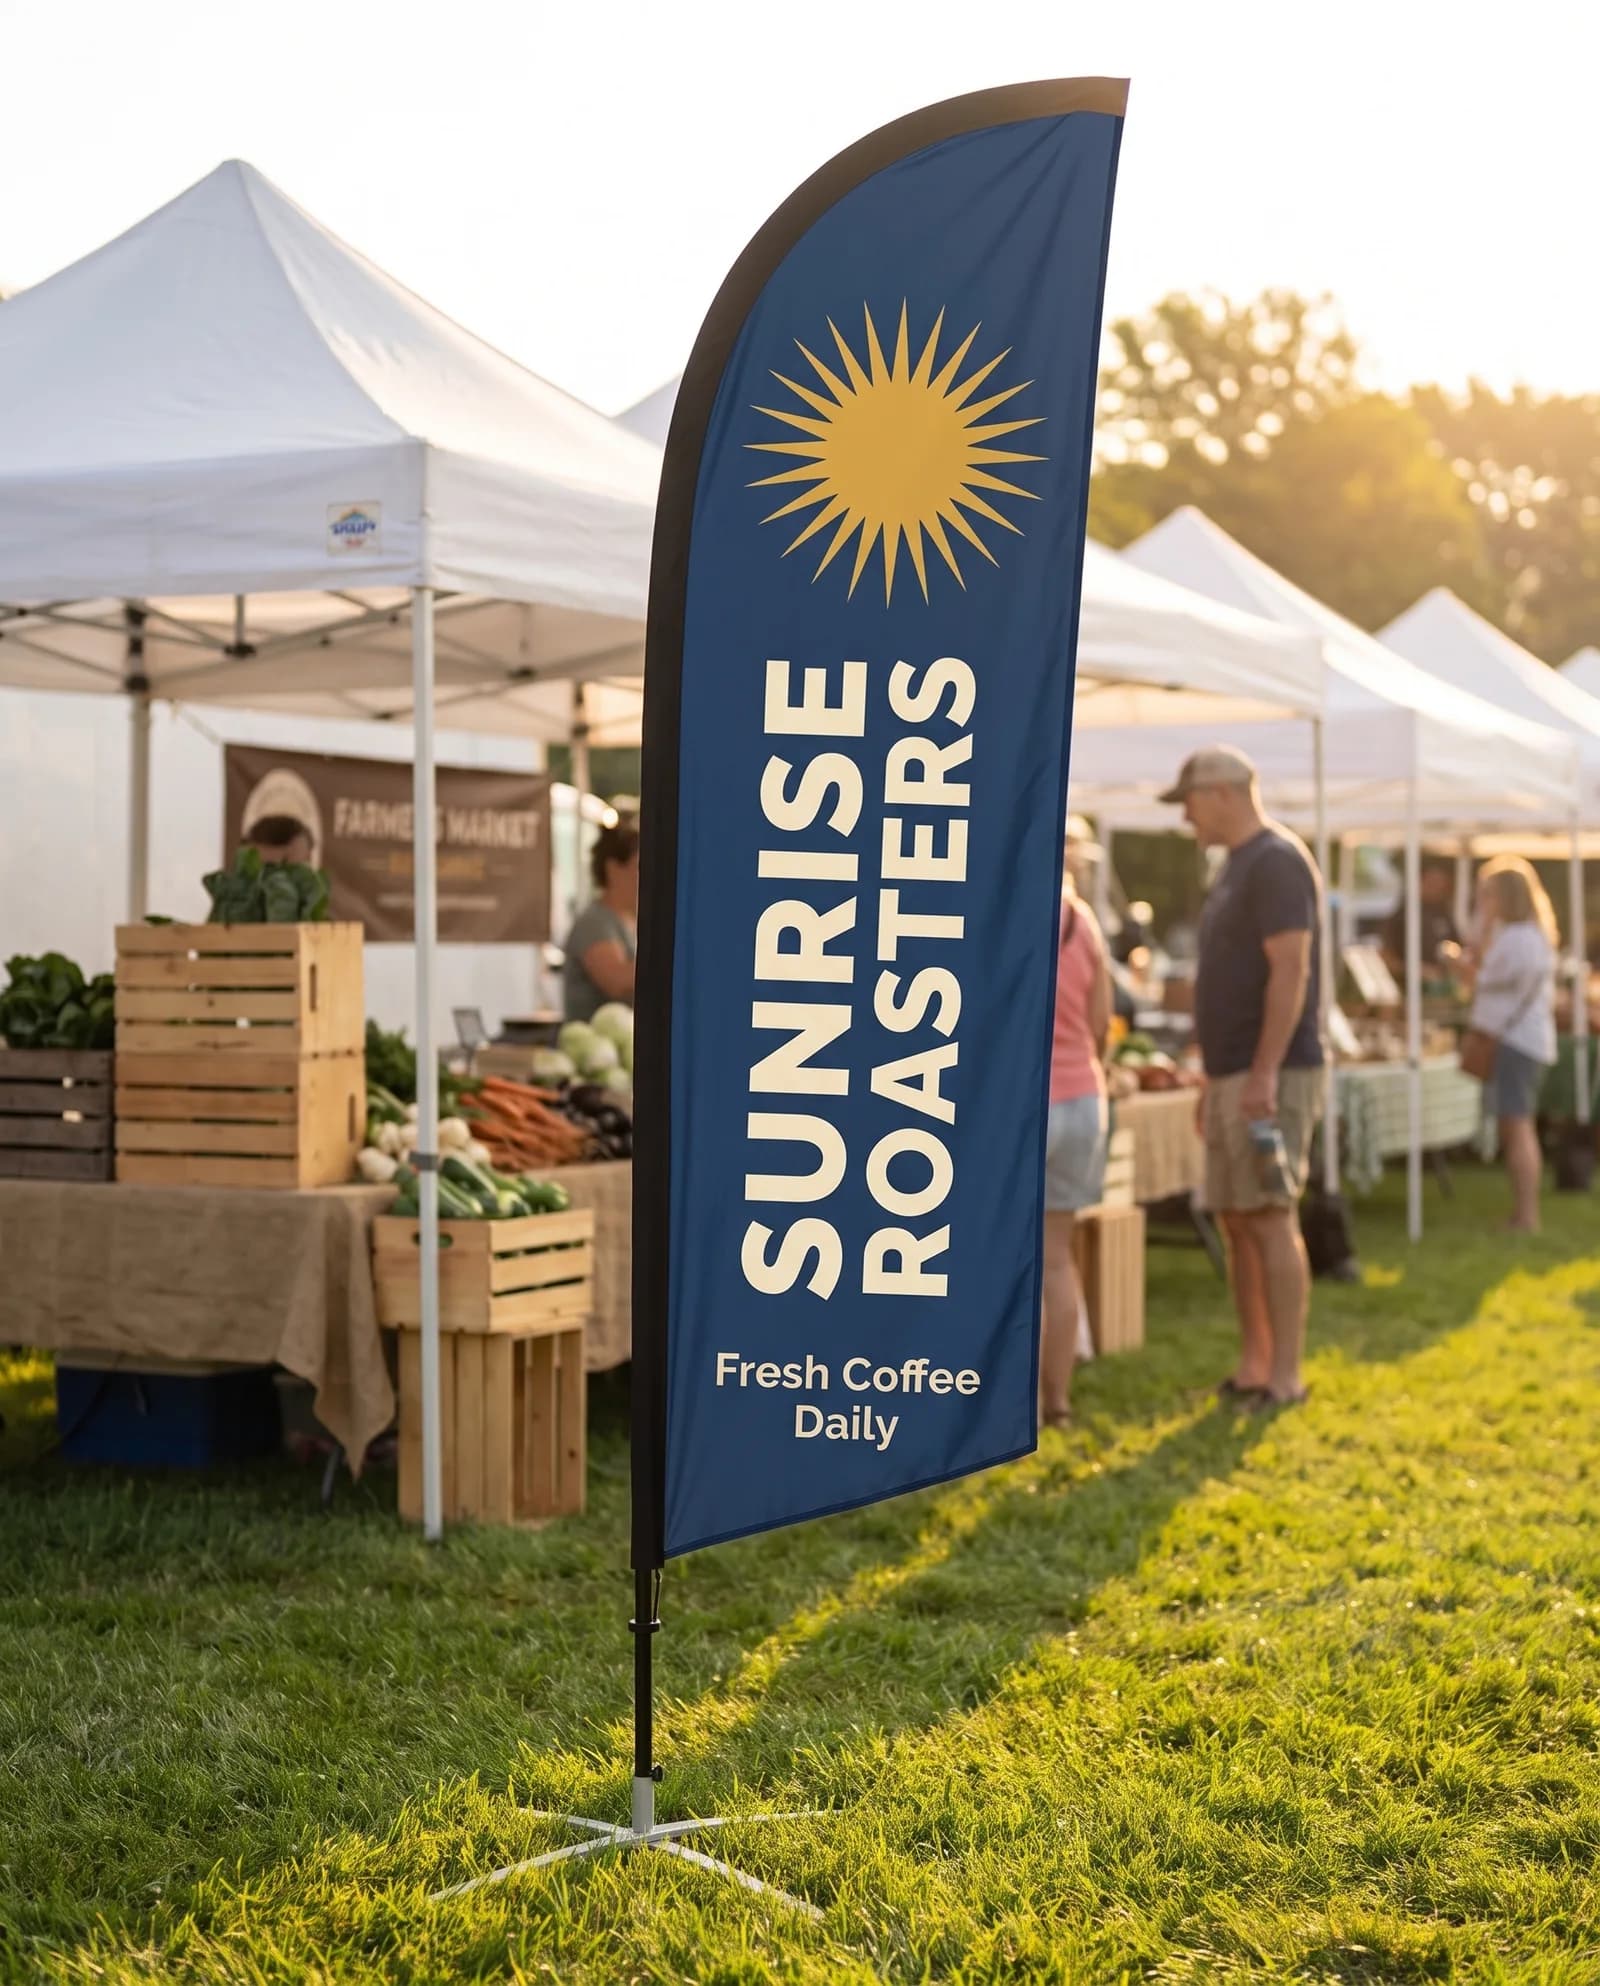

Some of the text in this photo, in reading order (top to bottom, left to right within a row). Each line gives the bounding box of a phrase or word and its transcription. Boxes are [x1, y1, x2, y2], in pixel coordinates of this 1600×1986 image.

[334, 798, 444, 844] FARMES
[740, 659, 868, 1301] SUNRISE
[862, 656, 977, 1297] ROASTERS
[716, 1352, 981, 1395] Fresh Coffee
[795, 1404, 899, 1451] Daily
